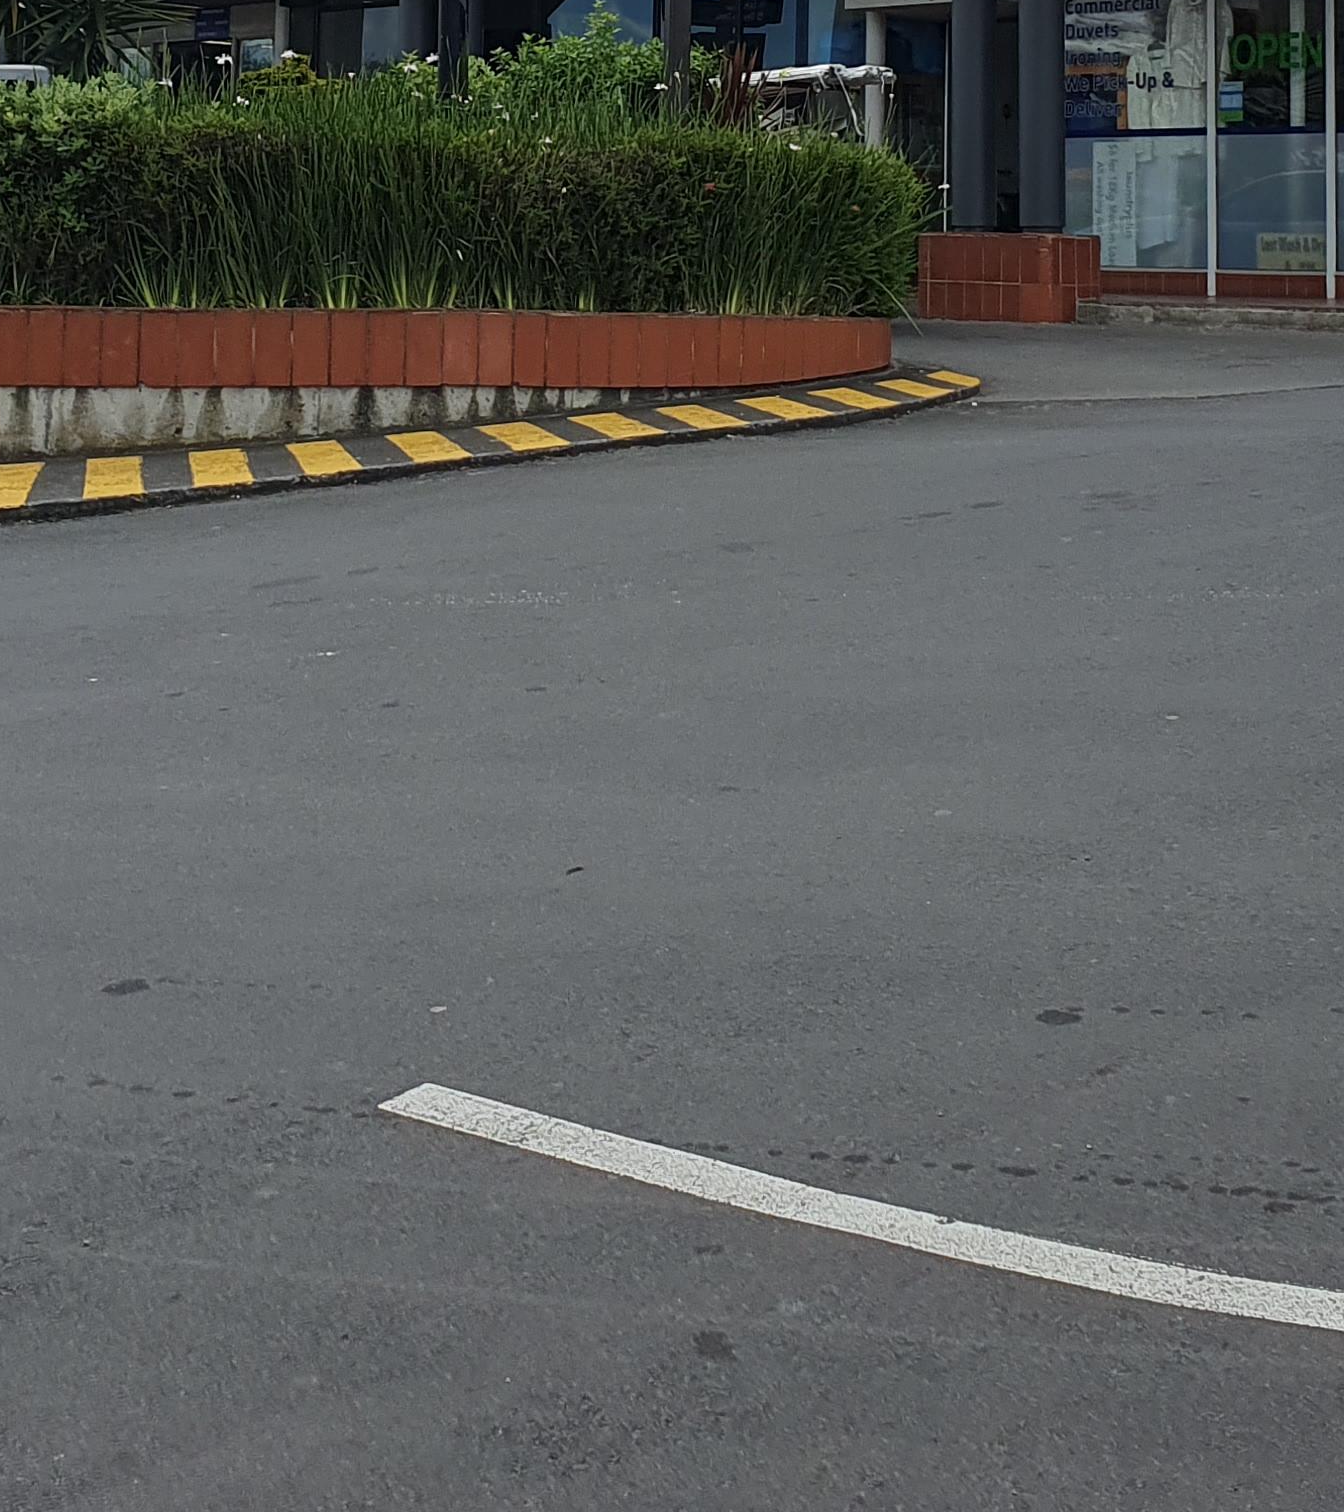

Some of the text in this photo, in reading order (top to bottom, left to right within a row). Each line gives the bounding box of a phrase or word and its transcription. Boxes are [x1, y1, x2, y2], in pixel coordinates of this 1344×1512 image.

[1065, 23, 1119, 40] Duvets
[1065, 47, 1121, 66] Ironing
[1232, 32, 1323, 71] OPEN
[1162, 71, 1174, 88] &
